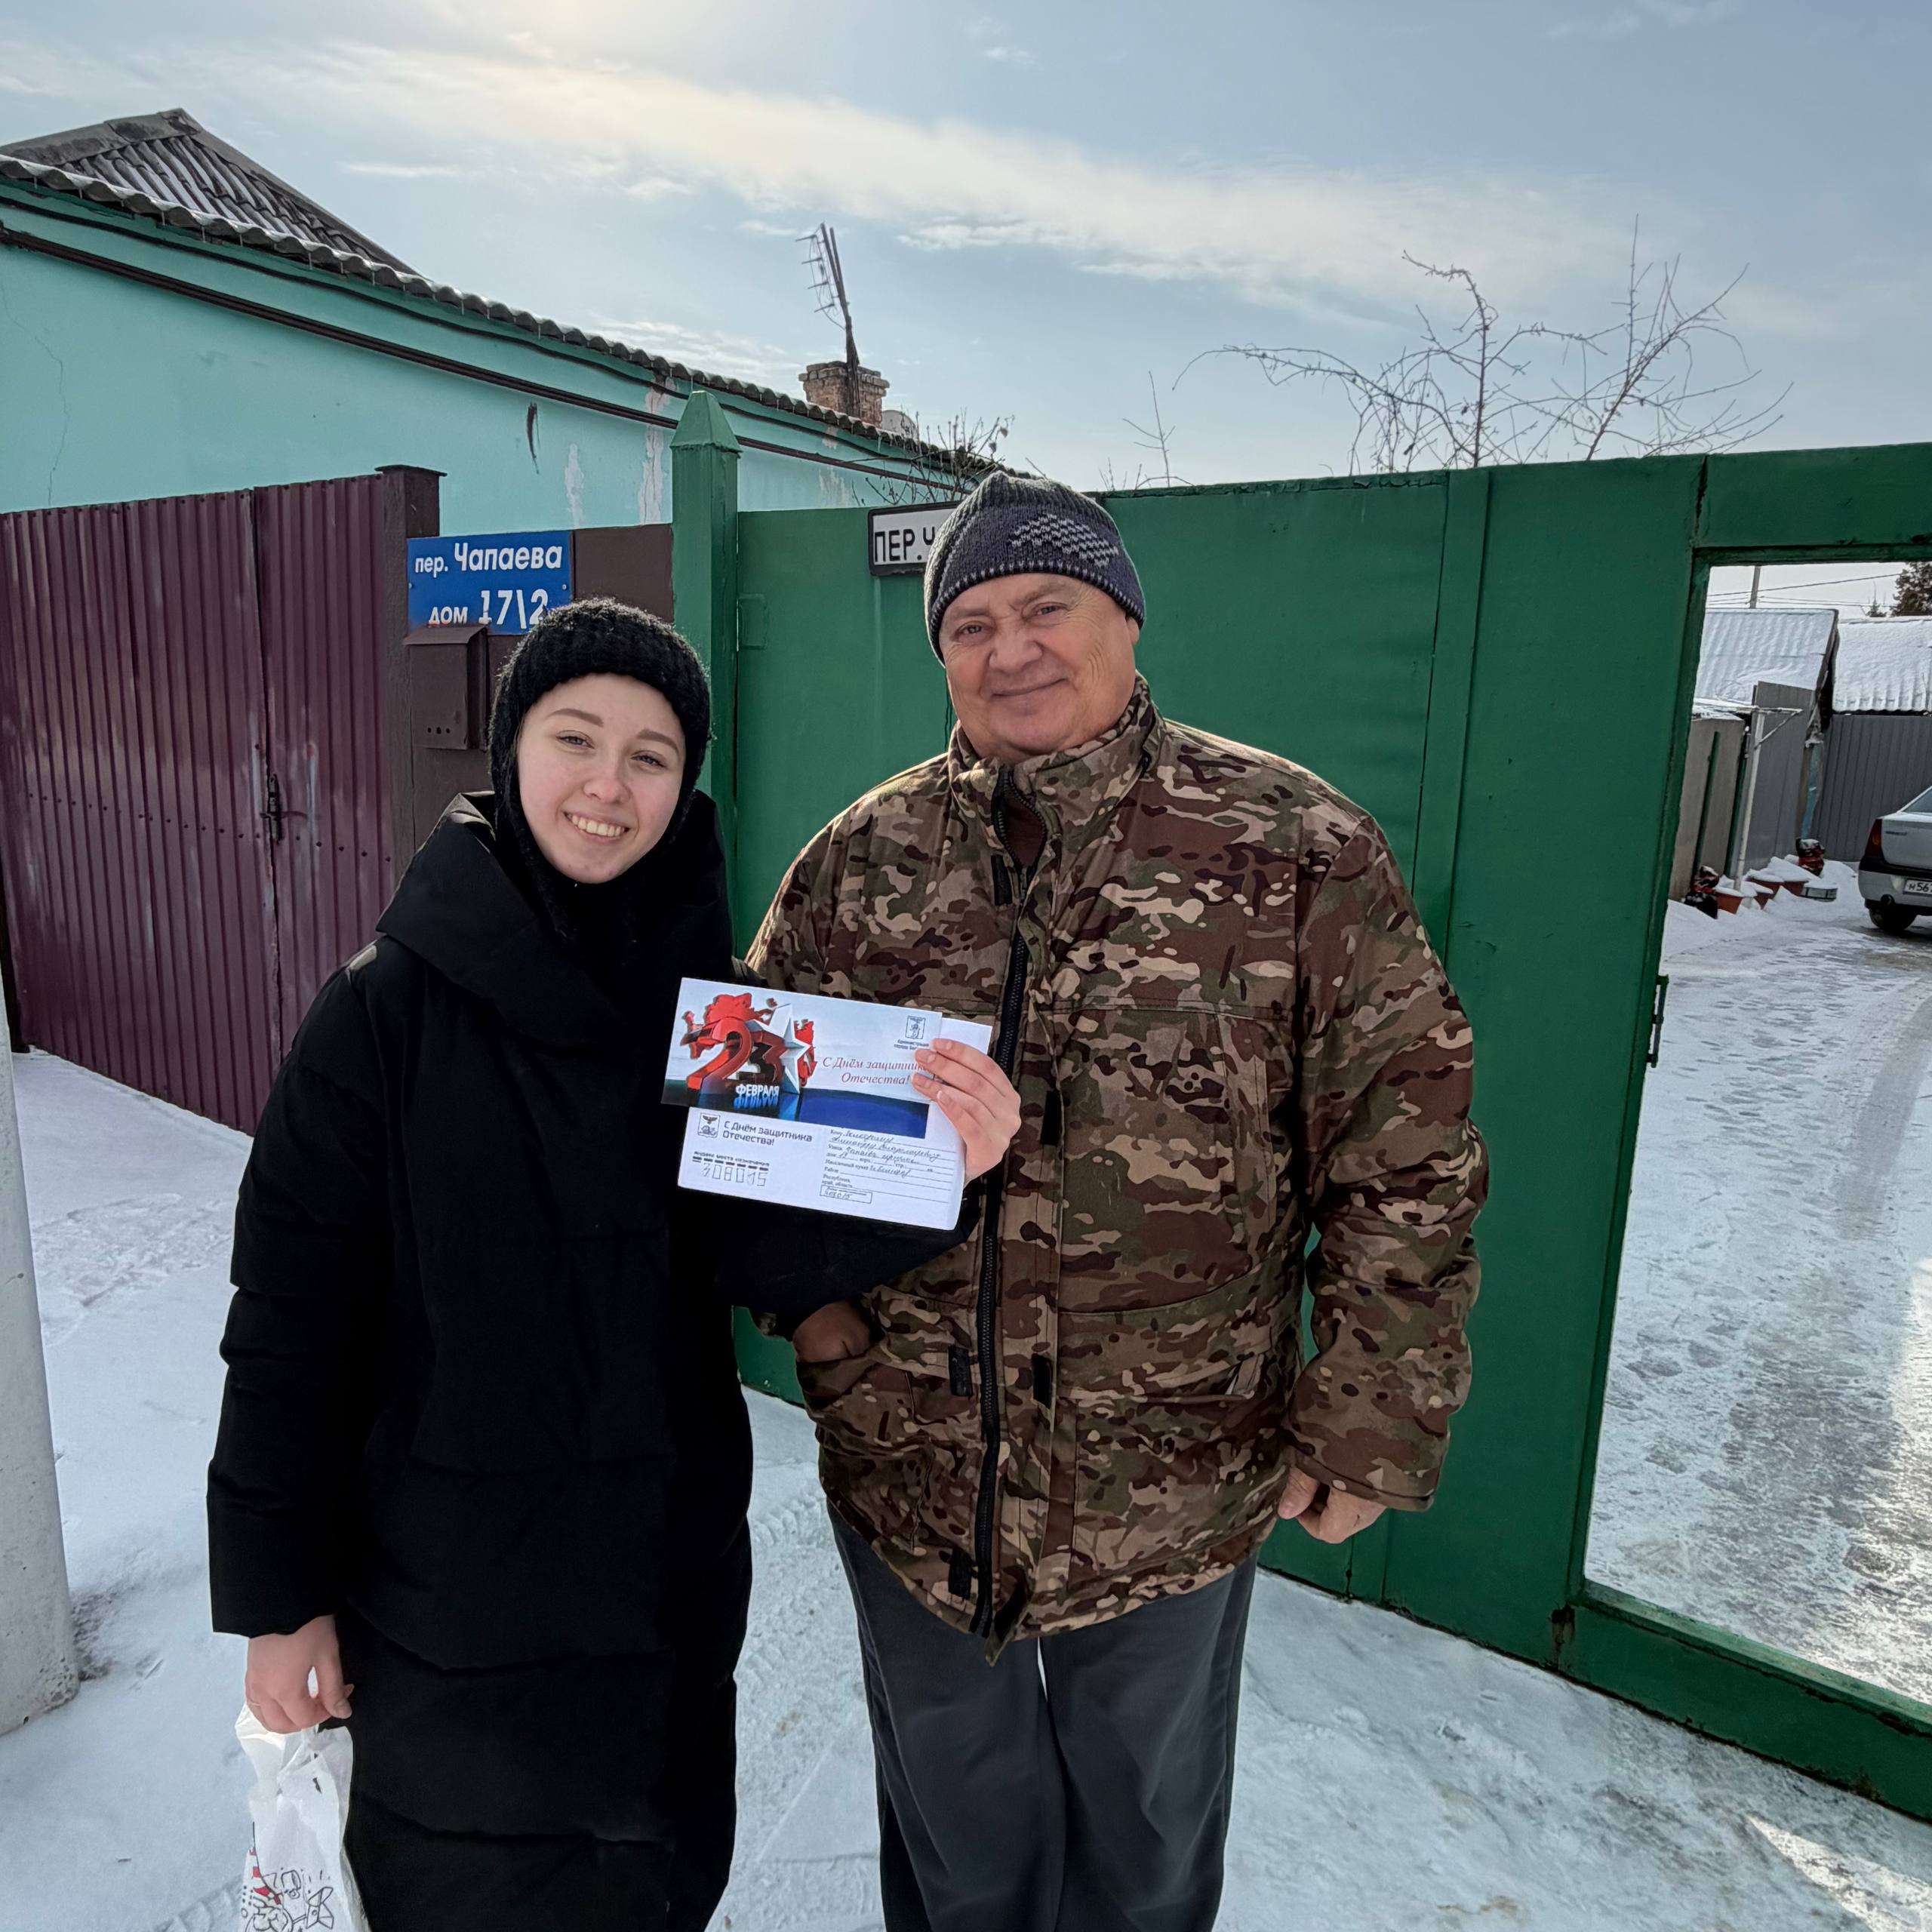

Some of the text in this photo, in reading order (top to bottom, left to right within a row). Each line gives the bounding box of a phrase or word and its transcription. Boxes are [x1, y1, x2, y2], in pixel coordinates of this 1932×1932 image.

[874, 528, 922, 562] ПЕР.
[415, 542, 563, 578] пер. Чапаева
[478, 588, 549, 629] 17\2
[1909, 882, 1932, 893] Н56
[823, 1057, 832, 1067] С
[832, 1057, 863, 1069] Днём
[841, 1072, 910, 1085] Отечества!
[735, 1084, 780, 1099] ФЕВРАЛЯ
[722, 1130, 775, 1146] Отечества!
[724, 1121, 813, 1143] С Днём защитника
